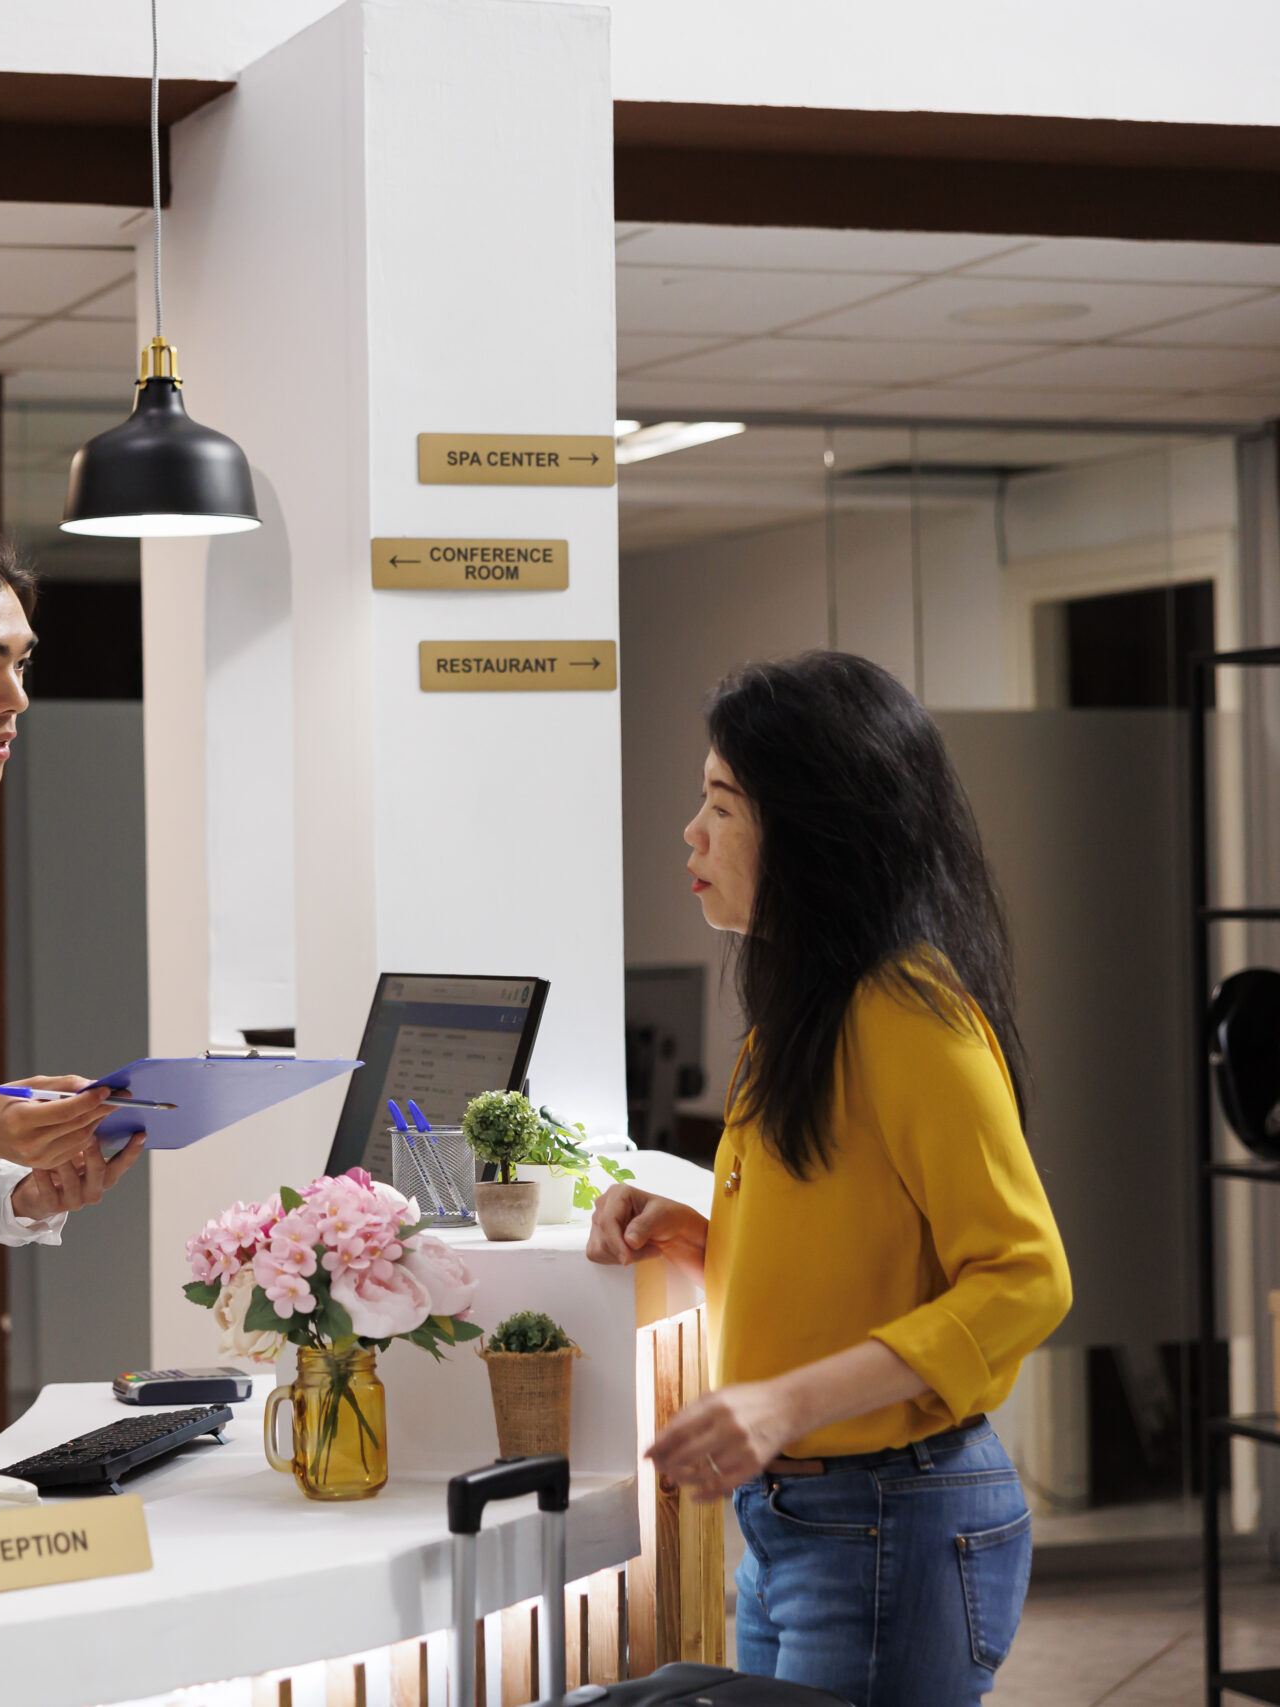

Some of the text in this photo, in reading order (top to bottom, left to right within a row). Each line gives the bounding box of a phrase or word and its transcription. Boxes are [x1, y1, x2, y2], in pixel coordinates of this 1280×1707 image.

[447, 451, 559, 467] SPA CENTER
[429, 547, 553, 563] CONFERENCE
[465, 566, 519, 580] ROOM
[436, 658, 557, 673] RESTAURANT
